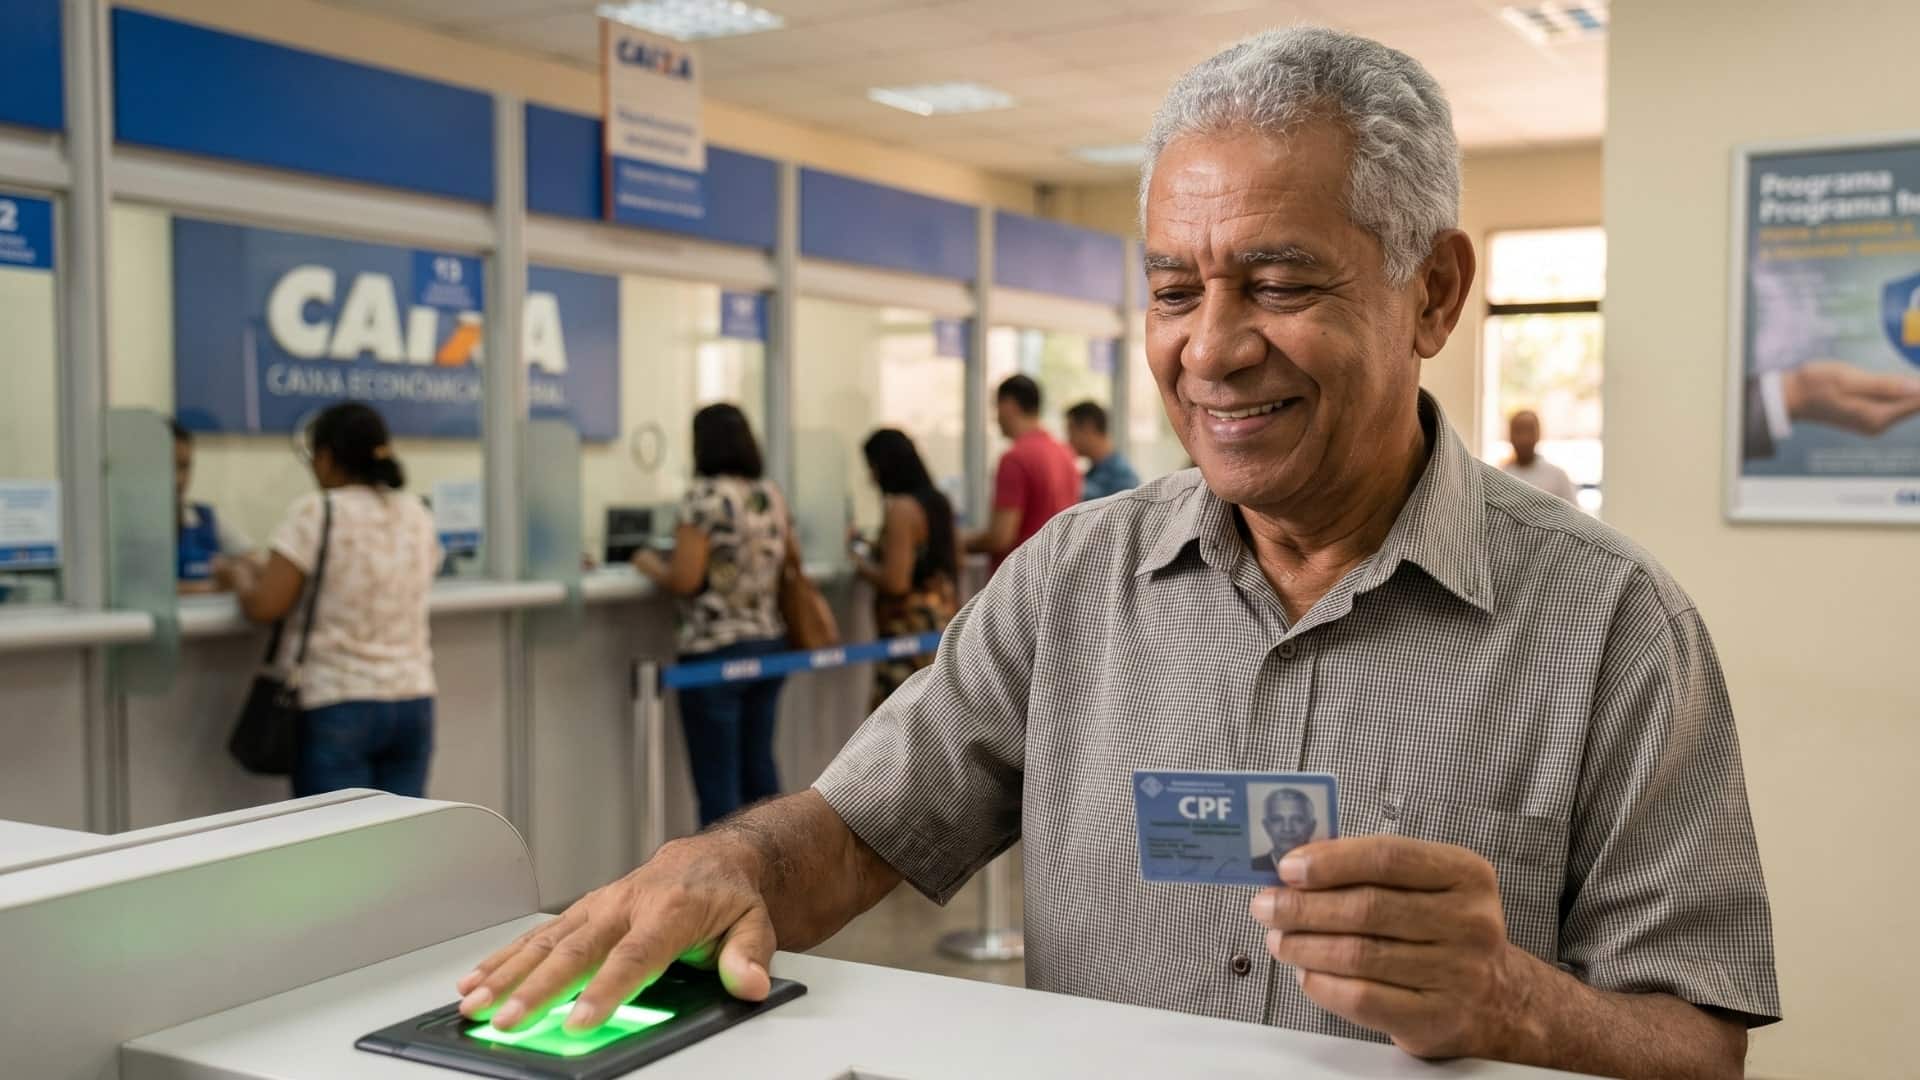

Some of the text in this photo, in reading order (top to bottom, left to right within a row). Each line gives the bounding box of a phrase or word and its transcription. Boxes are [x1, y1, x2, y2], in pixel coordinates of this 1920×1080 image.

[1760, 171, 1893, 201] Programa
[1760, 197, 1891, 224] Programa
[1179, 796, 1233, 821] CPF
